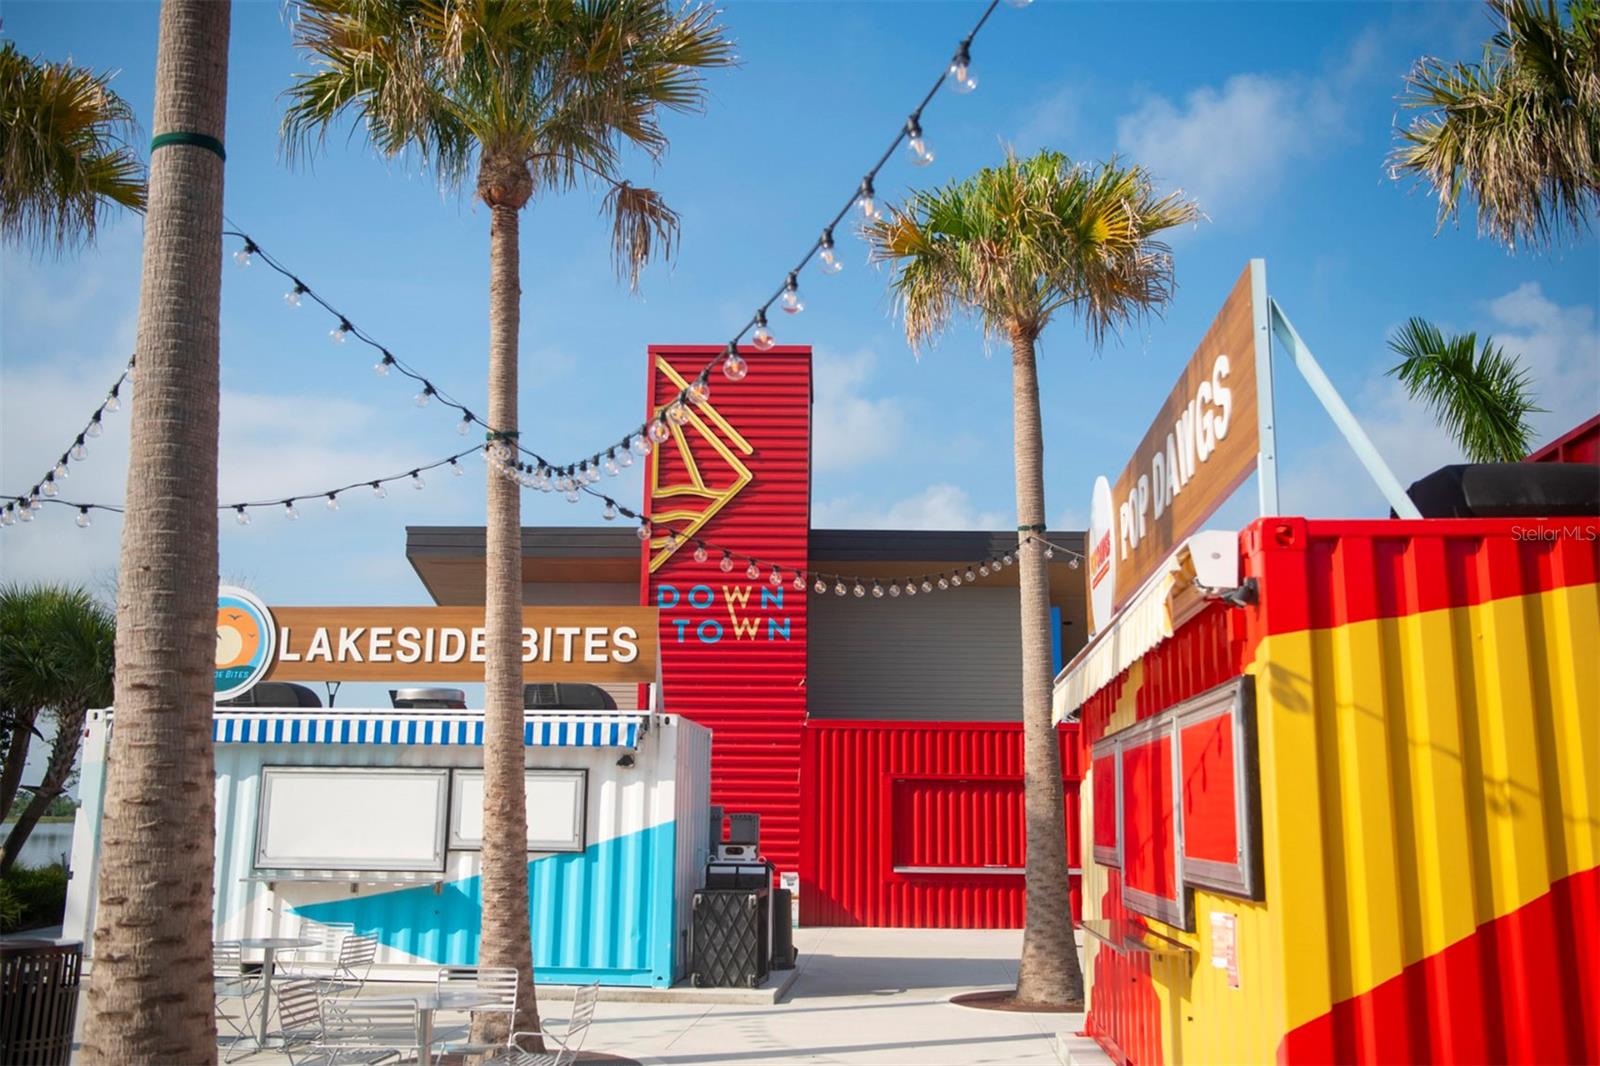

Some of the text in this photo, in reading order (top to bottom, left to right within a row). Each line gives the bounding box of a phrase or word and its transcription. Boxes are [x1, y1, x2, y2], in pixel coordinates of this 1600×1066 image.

[1120, 354, 1232, 561] POP DAWGS
[657, 585, 784, 609] DOWN
[279, 626, 638, 663] LAKESIDE BITES
[672, 618, 792, 644] TOWN
